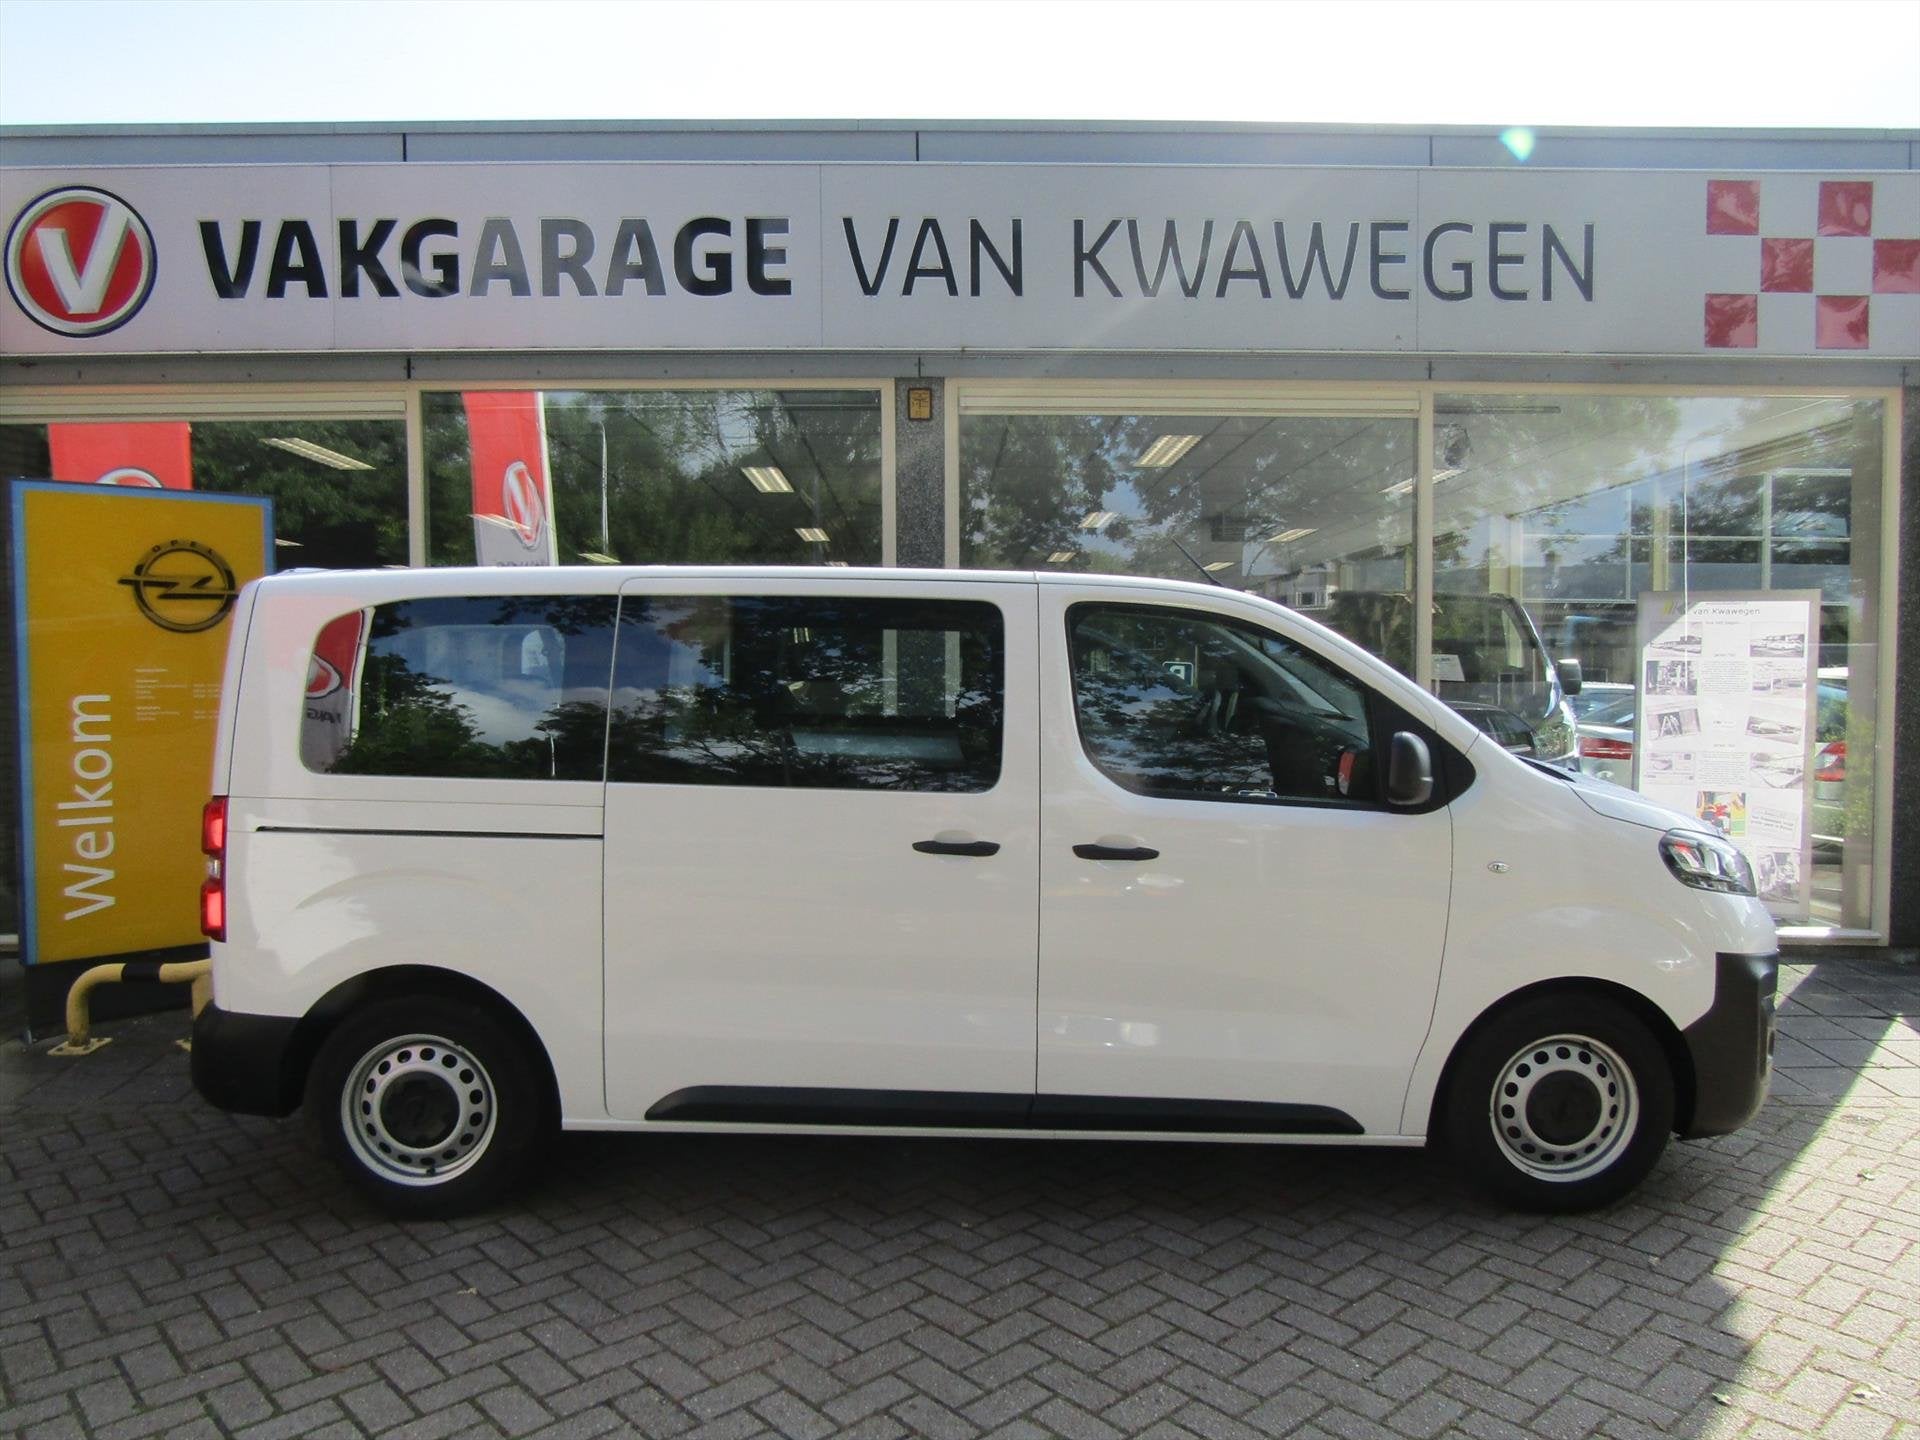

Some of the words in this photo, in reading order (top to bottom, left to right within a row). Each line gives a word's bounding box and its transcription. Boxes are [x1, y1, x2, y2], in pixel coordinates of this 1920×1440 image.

[199, 216, 793, 298] VAKGARAGE
[842, 217, 1023, 297] VAN
[1074, 218, 1596, 302] KWAWEGEN
[152, 539, 214, 556] OPEL
[58, 694, 116, 921] Welkom
